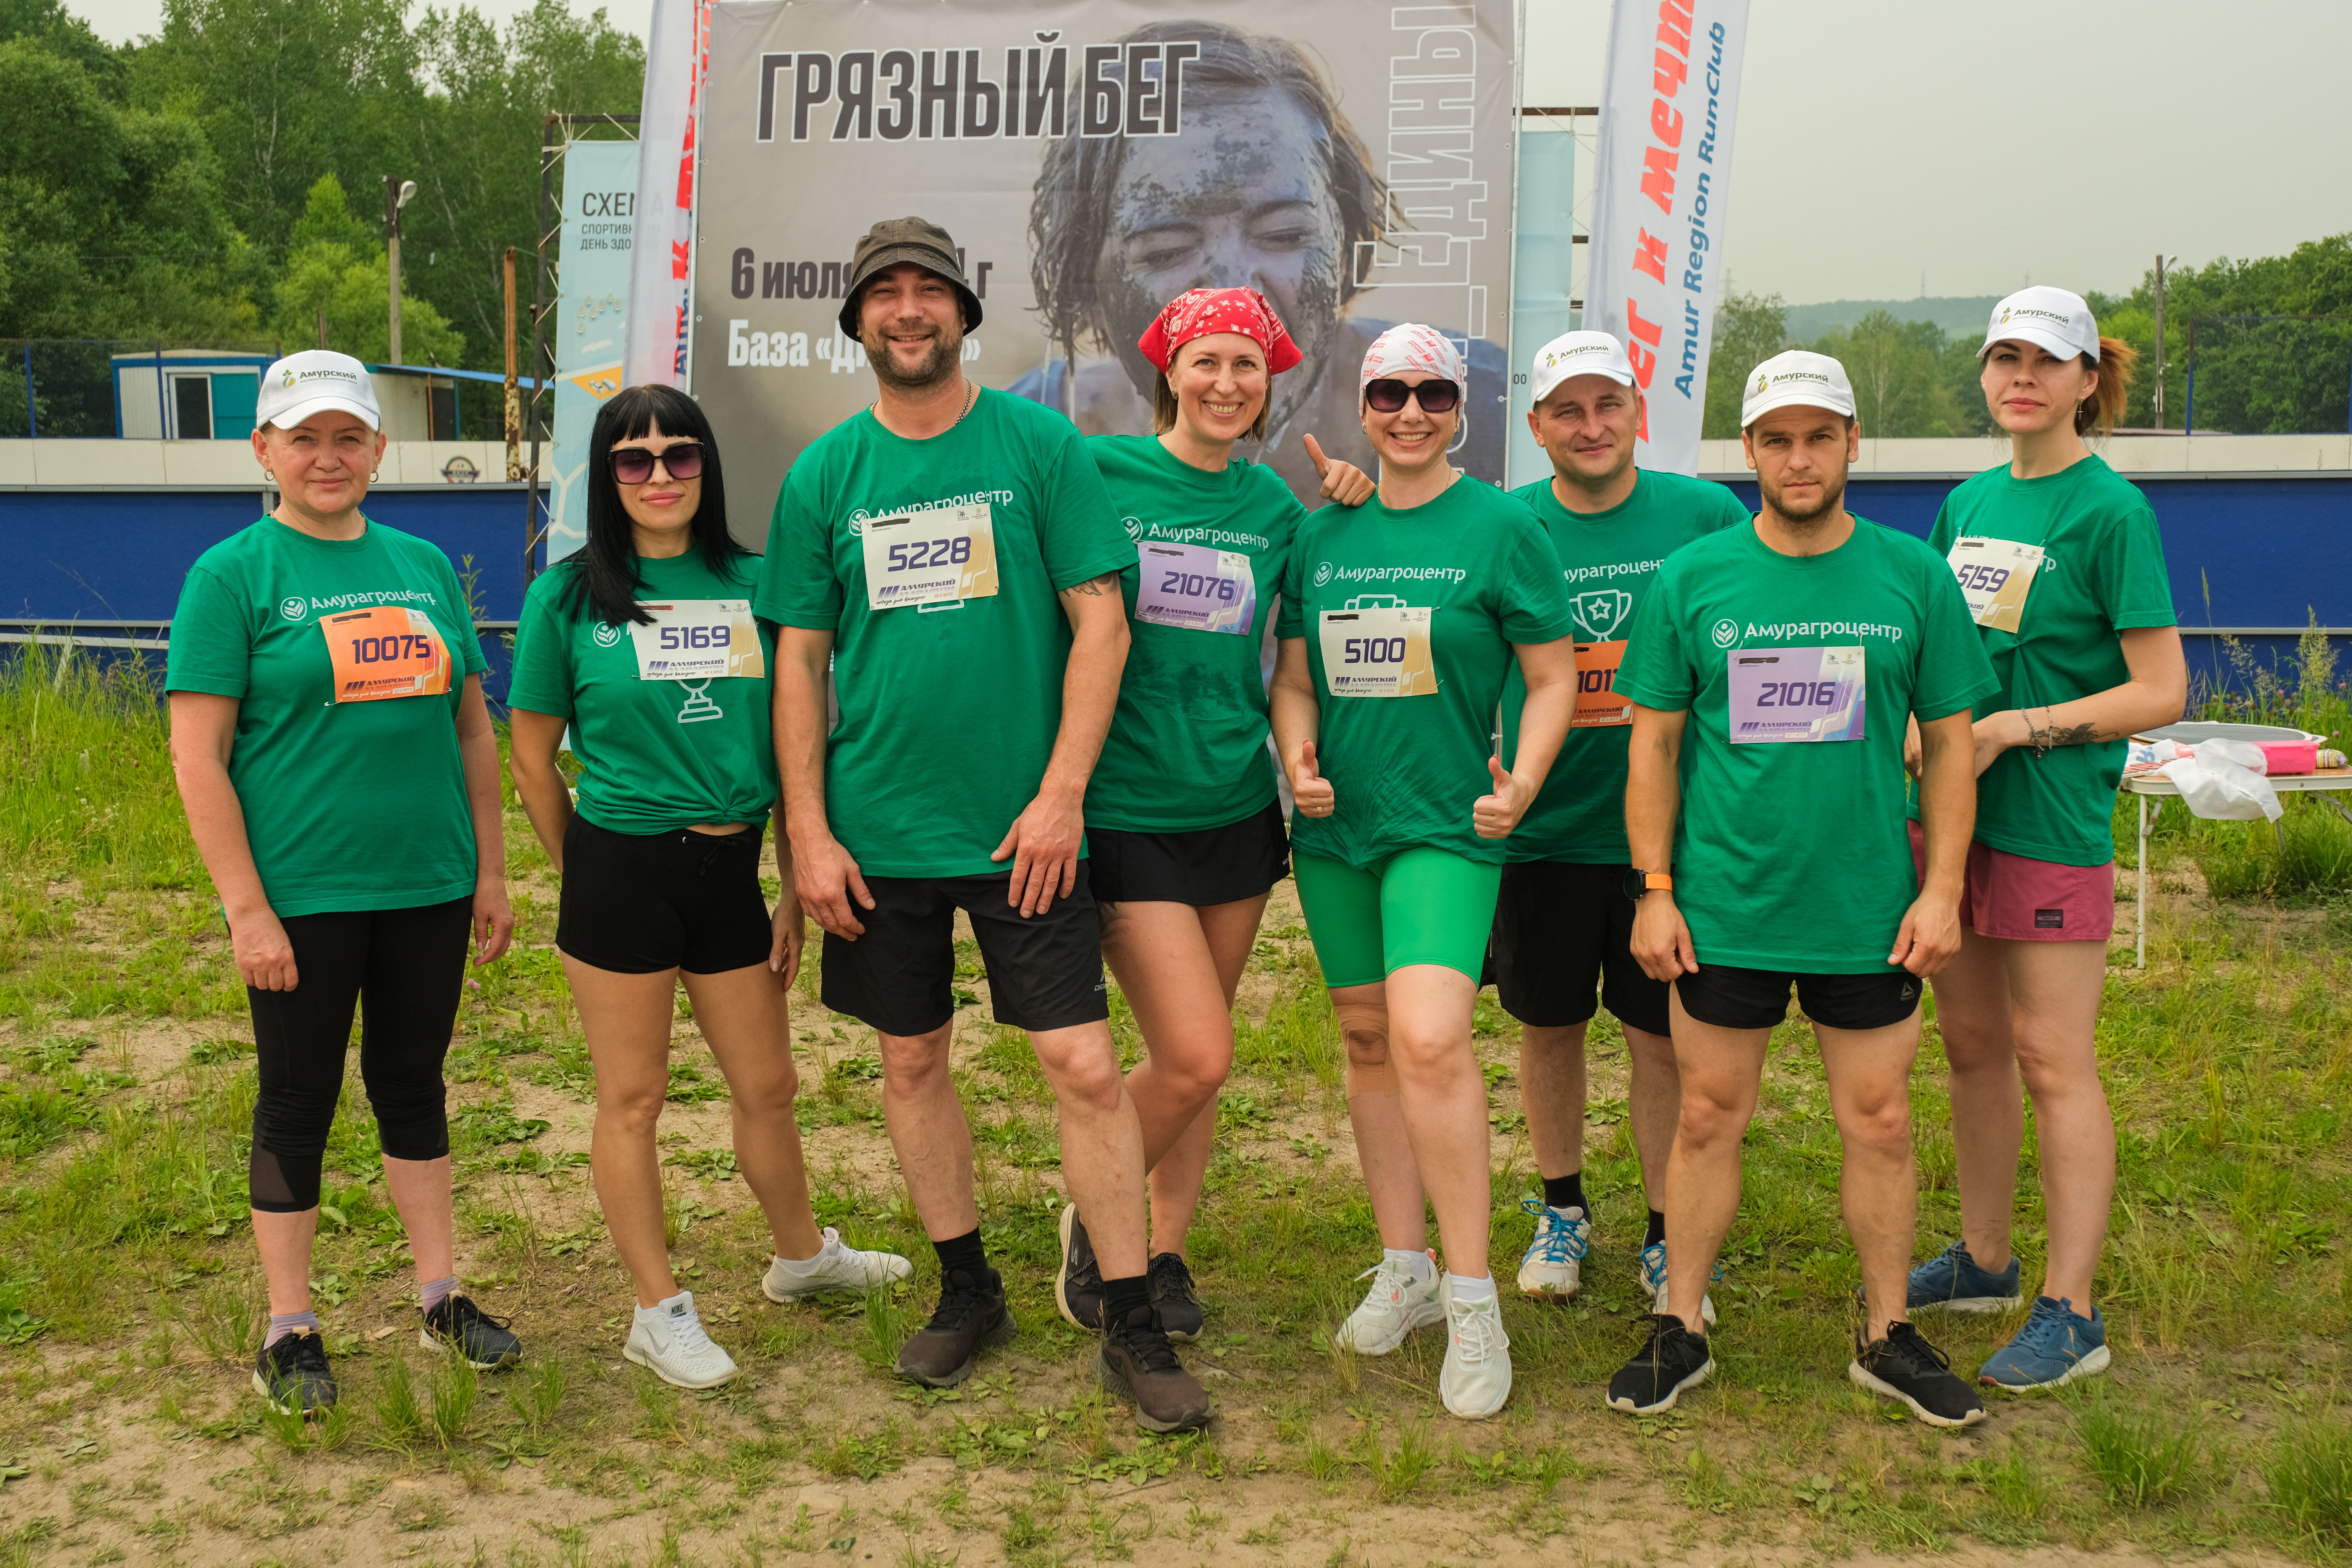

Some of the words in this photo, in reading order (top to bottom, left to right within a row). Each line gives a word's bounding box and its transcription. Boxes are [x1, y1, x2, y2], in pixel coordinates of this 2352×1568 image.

[756, 29, 1069, 143] ГРЯЗНЫЙ
[1080, 41, 1200, 138] БЕГ
[1698, 22, 1725, 164] RunClub
[580, 239, 608, 251] ДЕНЬ
[611, 239, 631, 250] ЗДО
[1683, 173, 1711, 293] Region
[731, 247, 754, 299] 6
[2014, 310, 2069, 324] Амурский
[727, 319, 809, 367] База
[1560, 346, 1609, 359] Амурский
[1675, 299, 1699, 400] Amur
[300, 370, 357, 380] Амурский
[1772, 373, 1829, 383] Амурский
[1149, 523, 1269, 552] Амурагроцентр
[888, 536, 971, 572] 5228
[1334, 566, 1466, 584] Амурагроцентр
[1564, 559, 1665, 583] урагроцен
[1957, 564, 2010, 593] 5159
[901, 579, 956, 591] АМУРСКИЙ
[1160, 571, 1235, 600] 21076
[312, 589, 436, 609] Амурагроцентр
[1165, 608, 1209, 617] АМУРСКИЙ
[661, 625, 730, 649] 5169
[1744, 622, 1902, 643] Амурагроцентр
[352, 635, 431, 664] 10075
[1345, 637, 1406, 664] 5100
[367, 676, 415, 686] АМУРСКИЙ
[1757, 681, 1836, 707] 21016
[671, 1303, 683, 1316] NIKE
